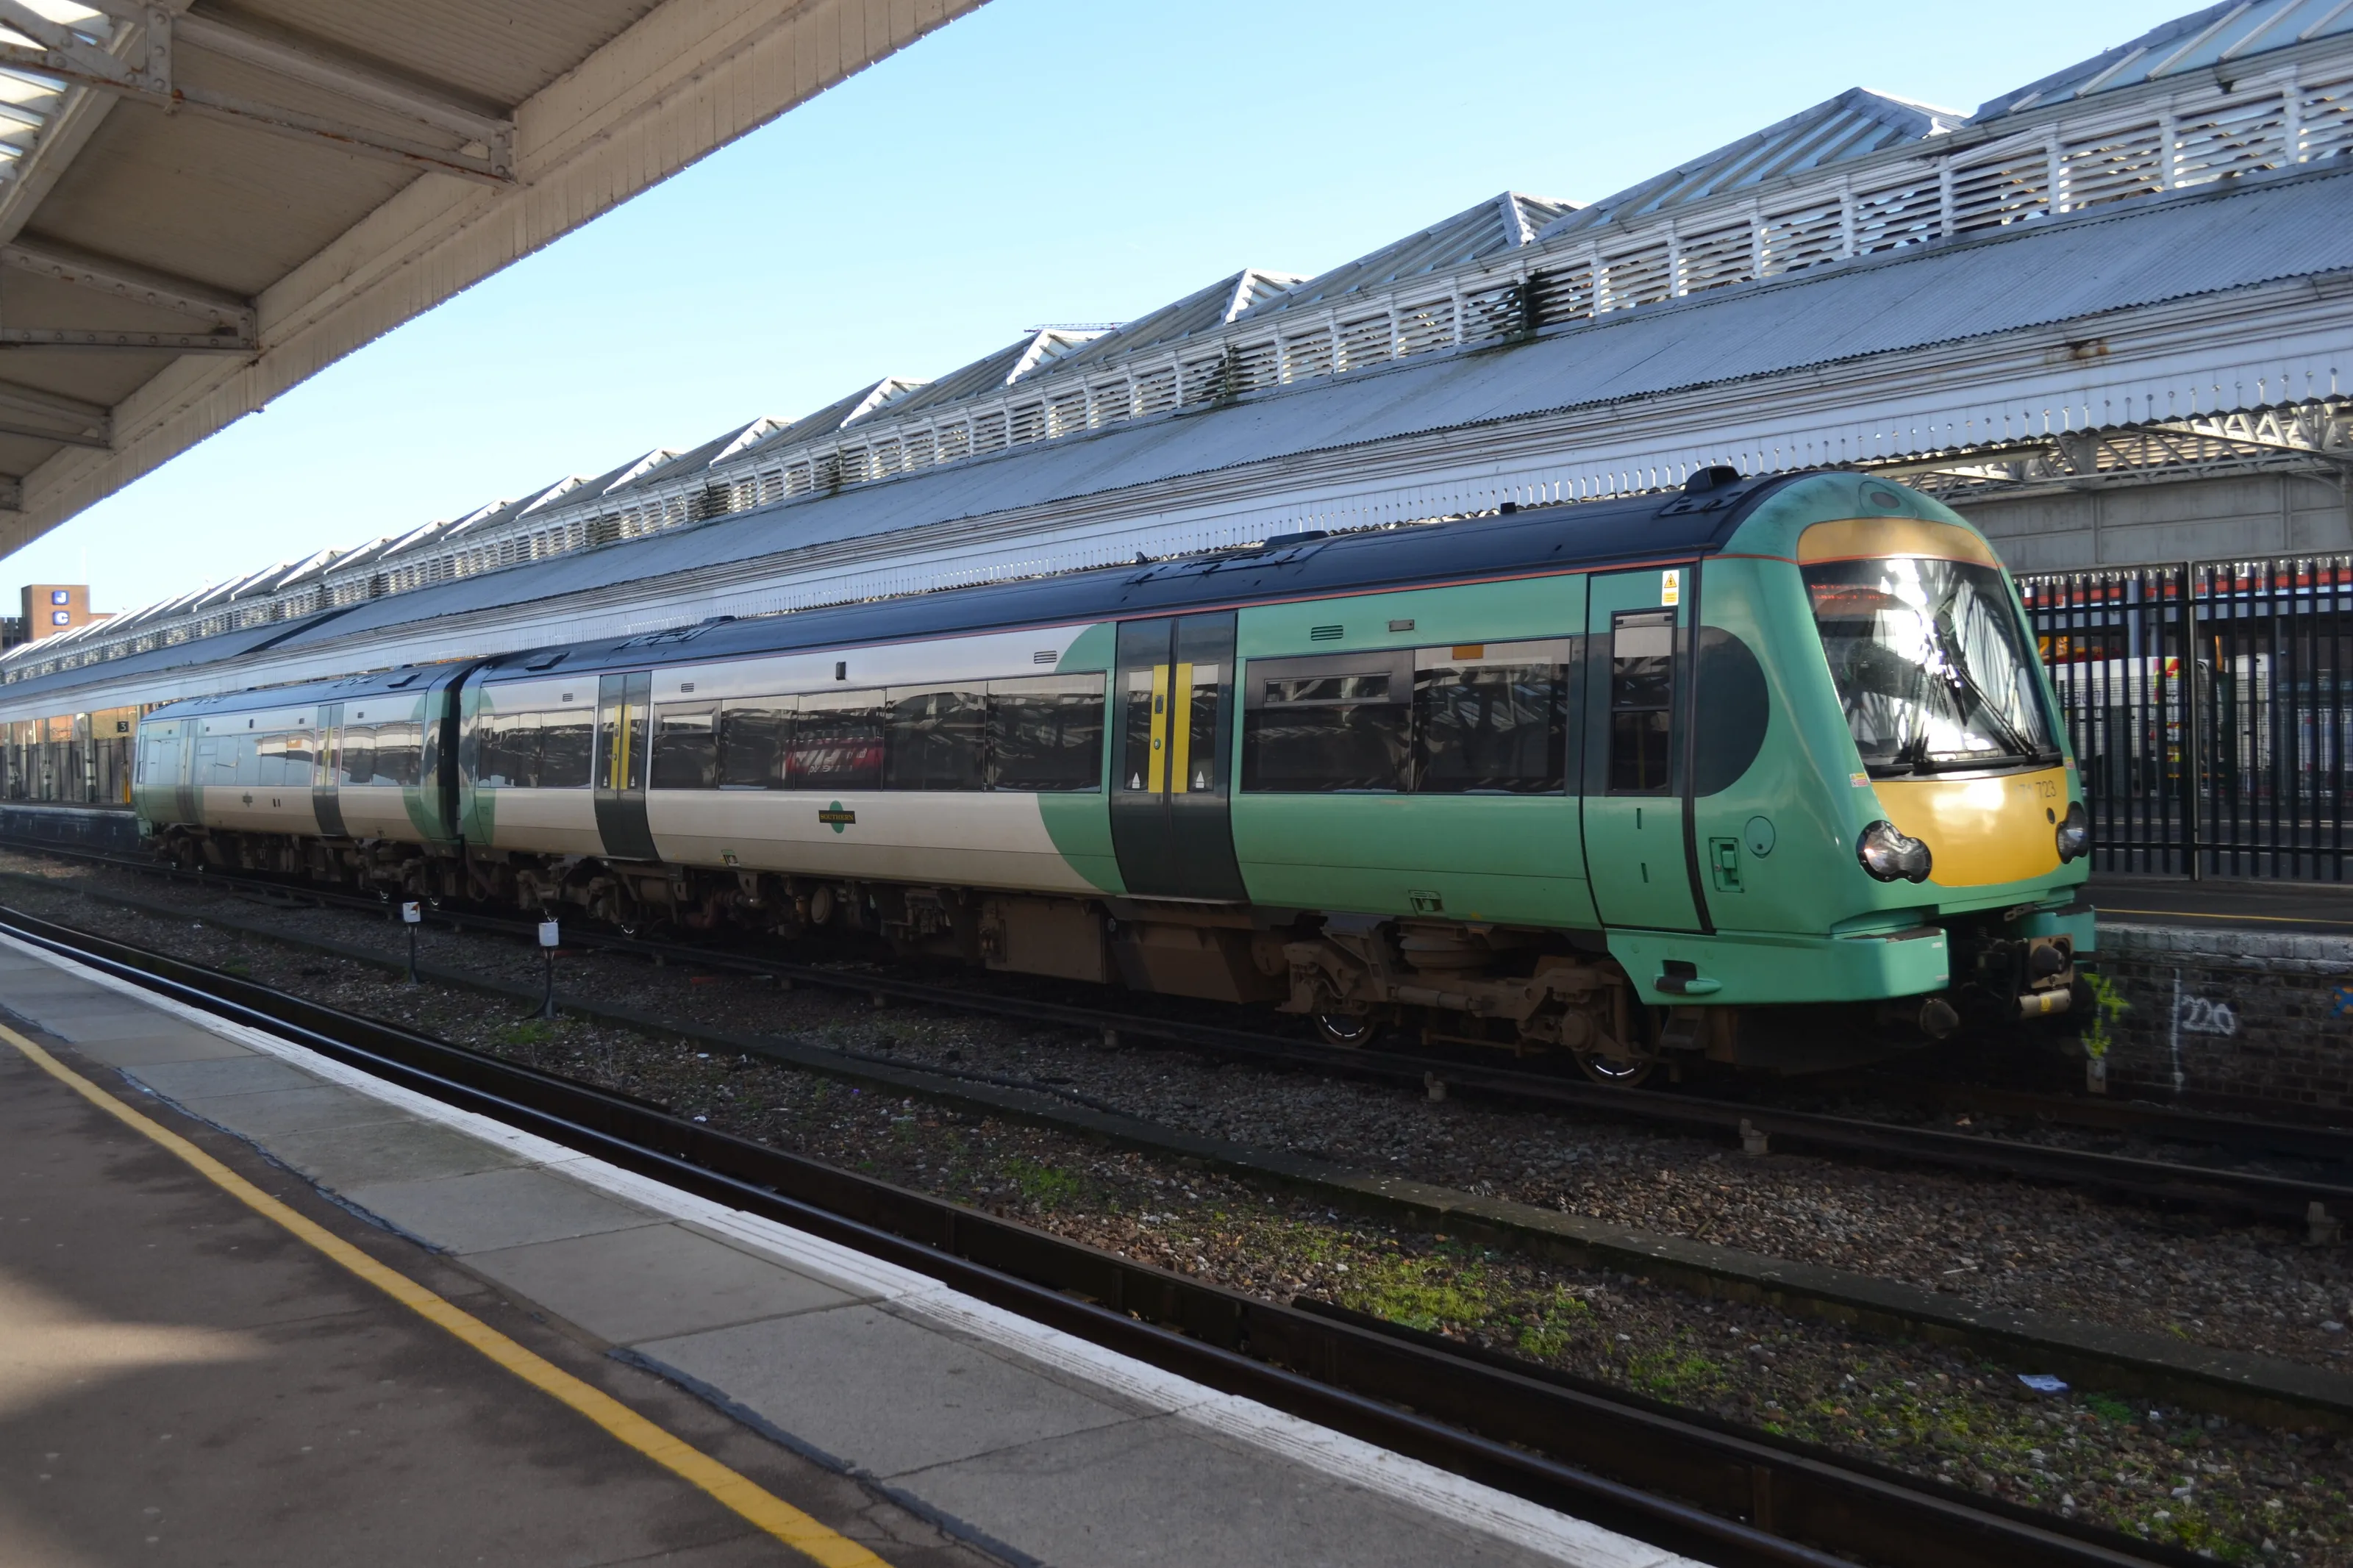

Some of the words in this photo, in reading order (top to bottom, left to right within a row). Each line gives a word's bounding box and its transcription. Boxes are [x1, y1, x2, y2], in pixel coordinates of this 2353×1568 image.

[120, 722, 126, 731] 3
[2035, 780, 2057, 799] 723
[2181, 995, 2235, 1035] 220
